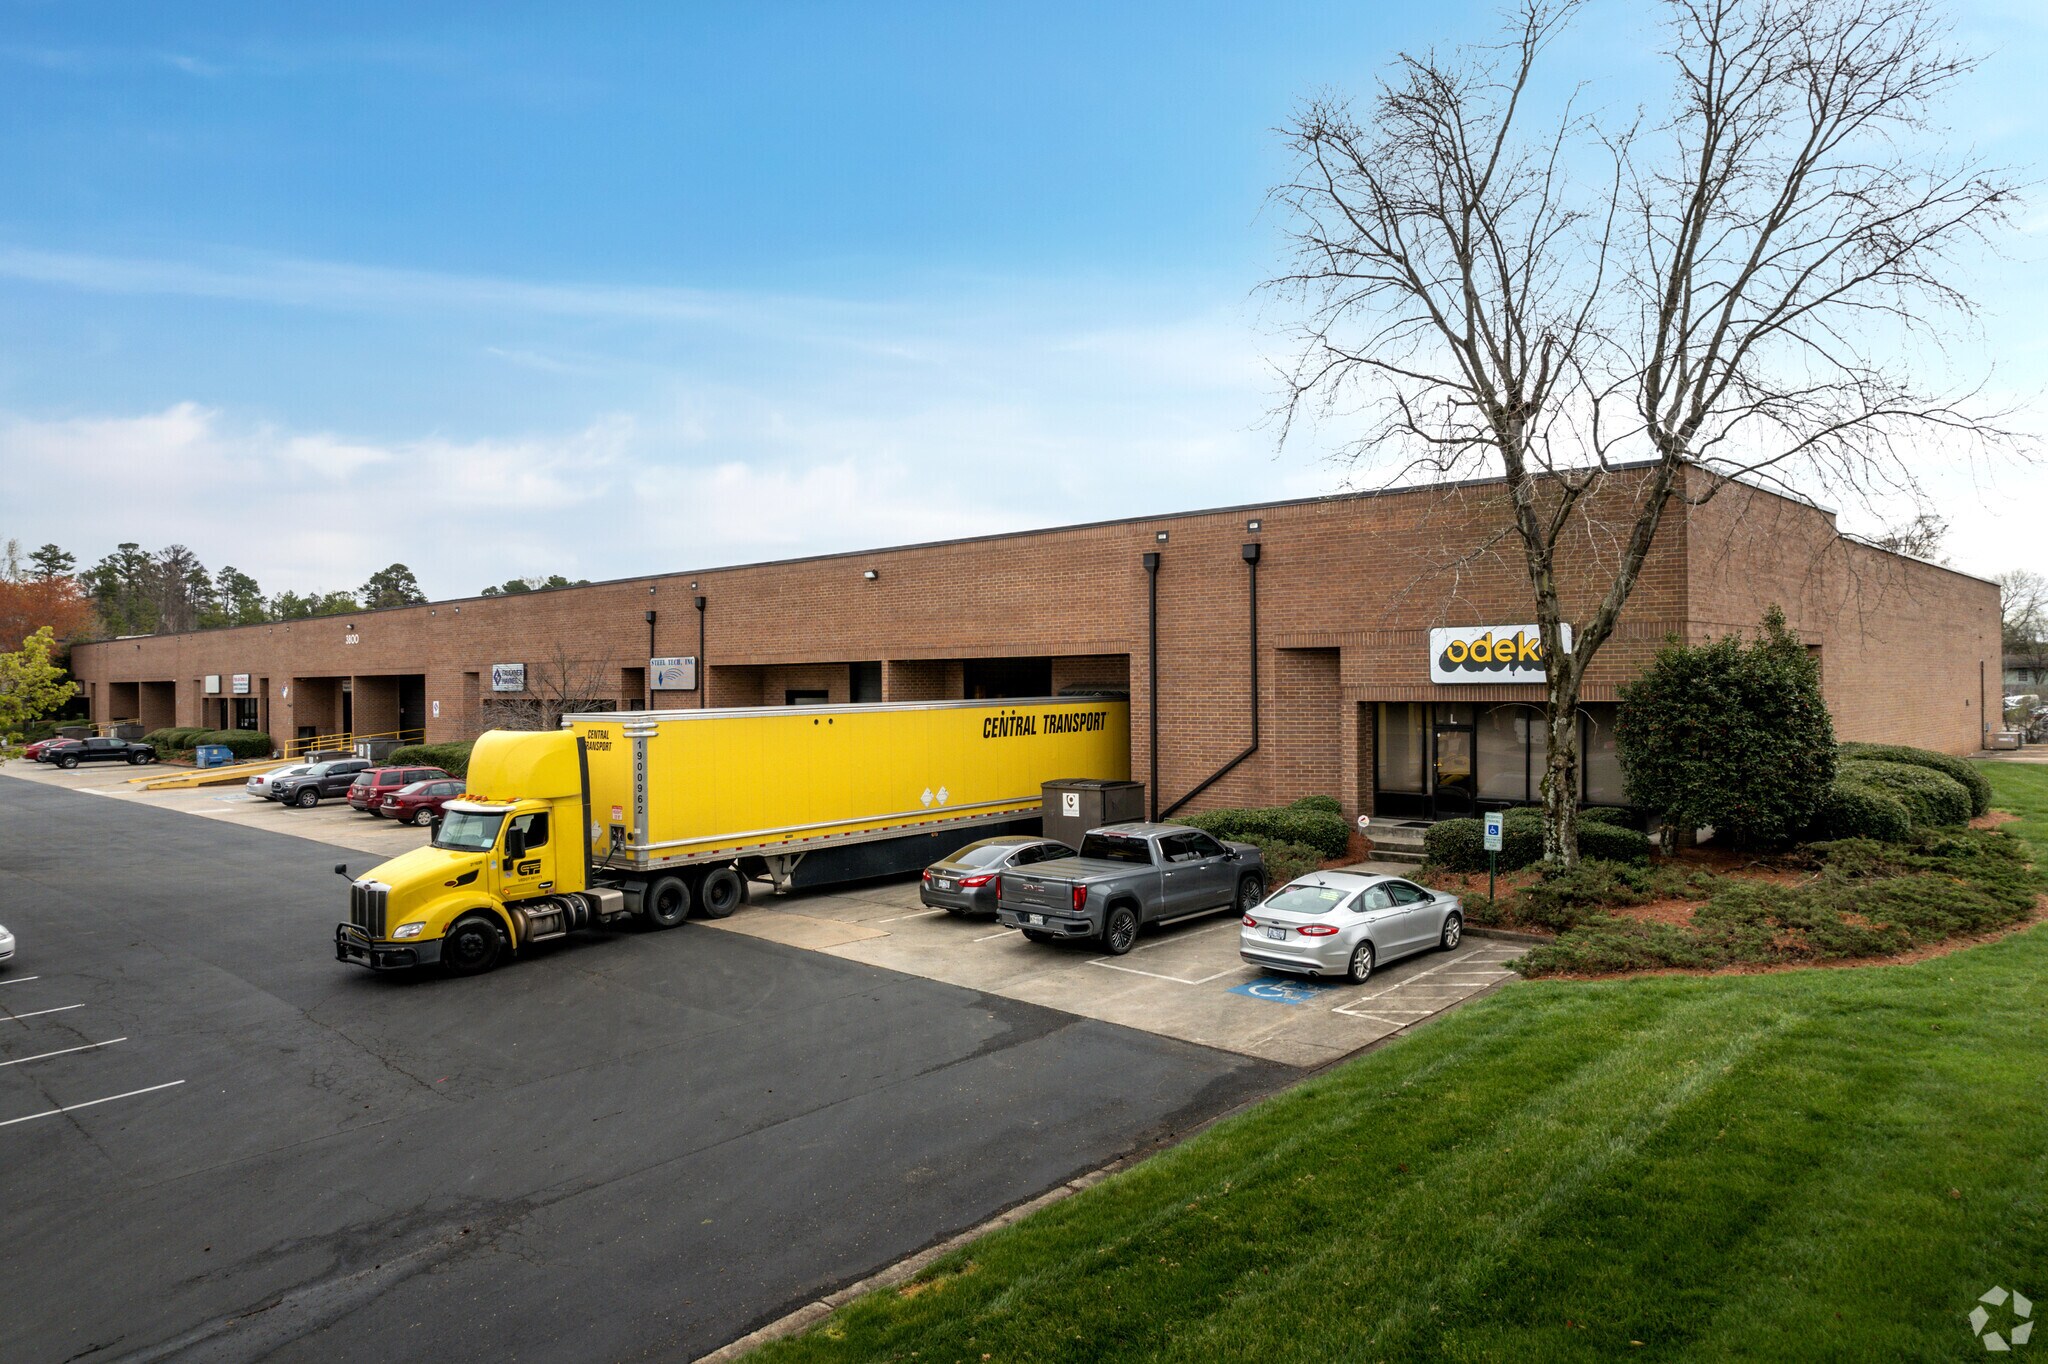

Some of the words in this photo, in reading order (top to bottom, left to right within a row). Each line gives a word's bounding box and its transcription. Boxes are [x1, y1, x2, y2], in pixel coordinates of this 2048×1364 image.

[345, 634, 359, 644] 3800
[1450, 713, 1458, 724] L
[983, 715, 1037, 739] CENTRAL
[1043, 711, 1107, 734] TRANSPORT
[587, 729, 609, 740] CENTRAL
[586, 741, 612, 751] RANSPORT
